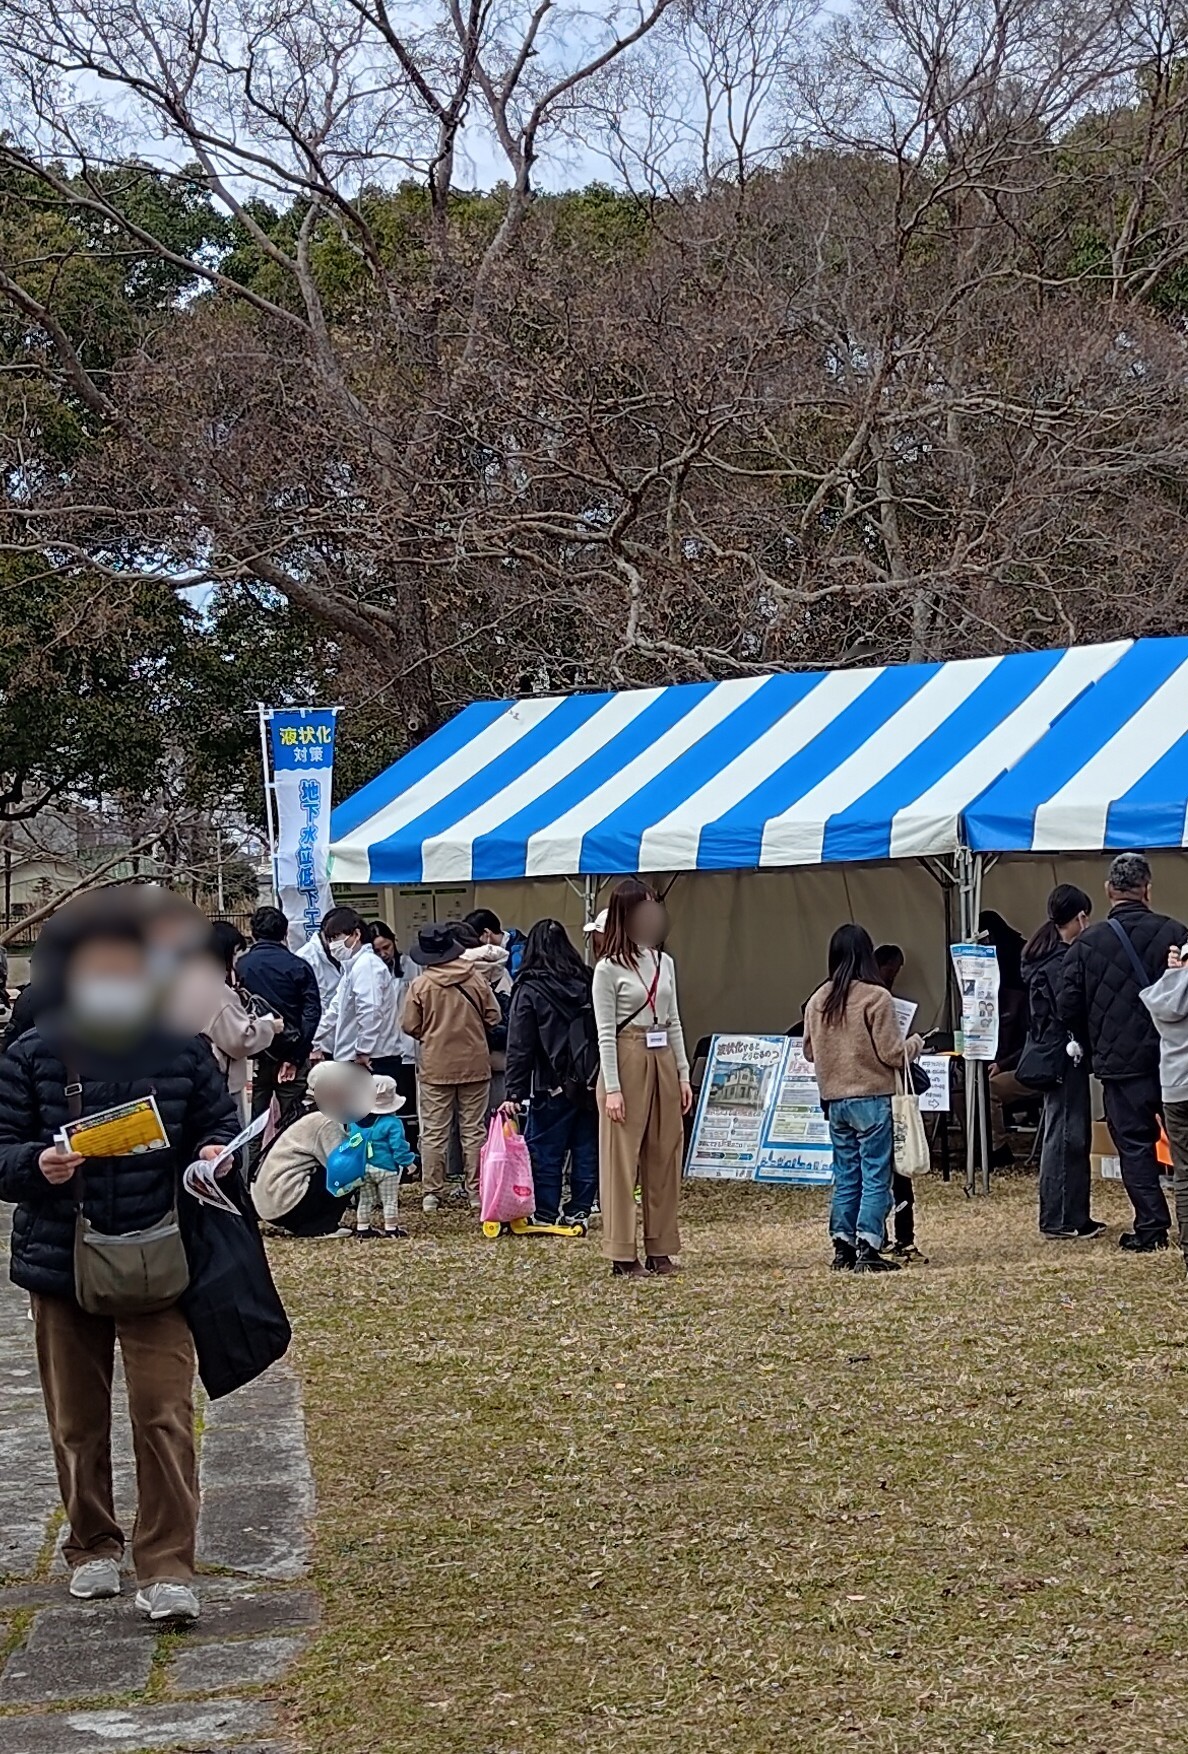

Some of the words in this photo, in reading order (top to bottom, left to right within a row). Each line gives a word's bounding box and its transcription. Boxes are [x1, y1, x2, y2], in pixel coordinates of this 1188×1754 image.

[279, 726, 332, 745] 液状化
[294, 747, 324, 763] 対策
